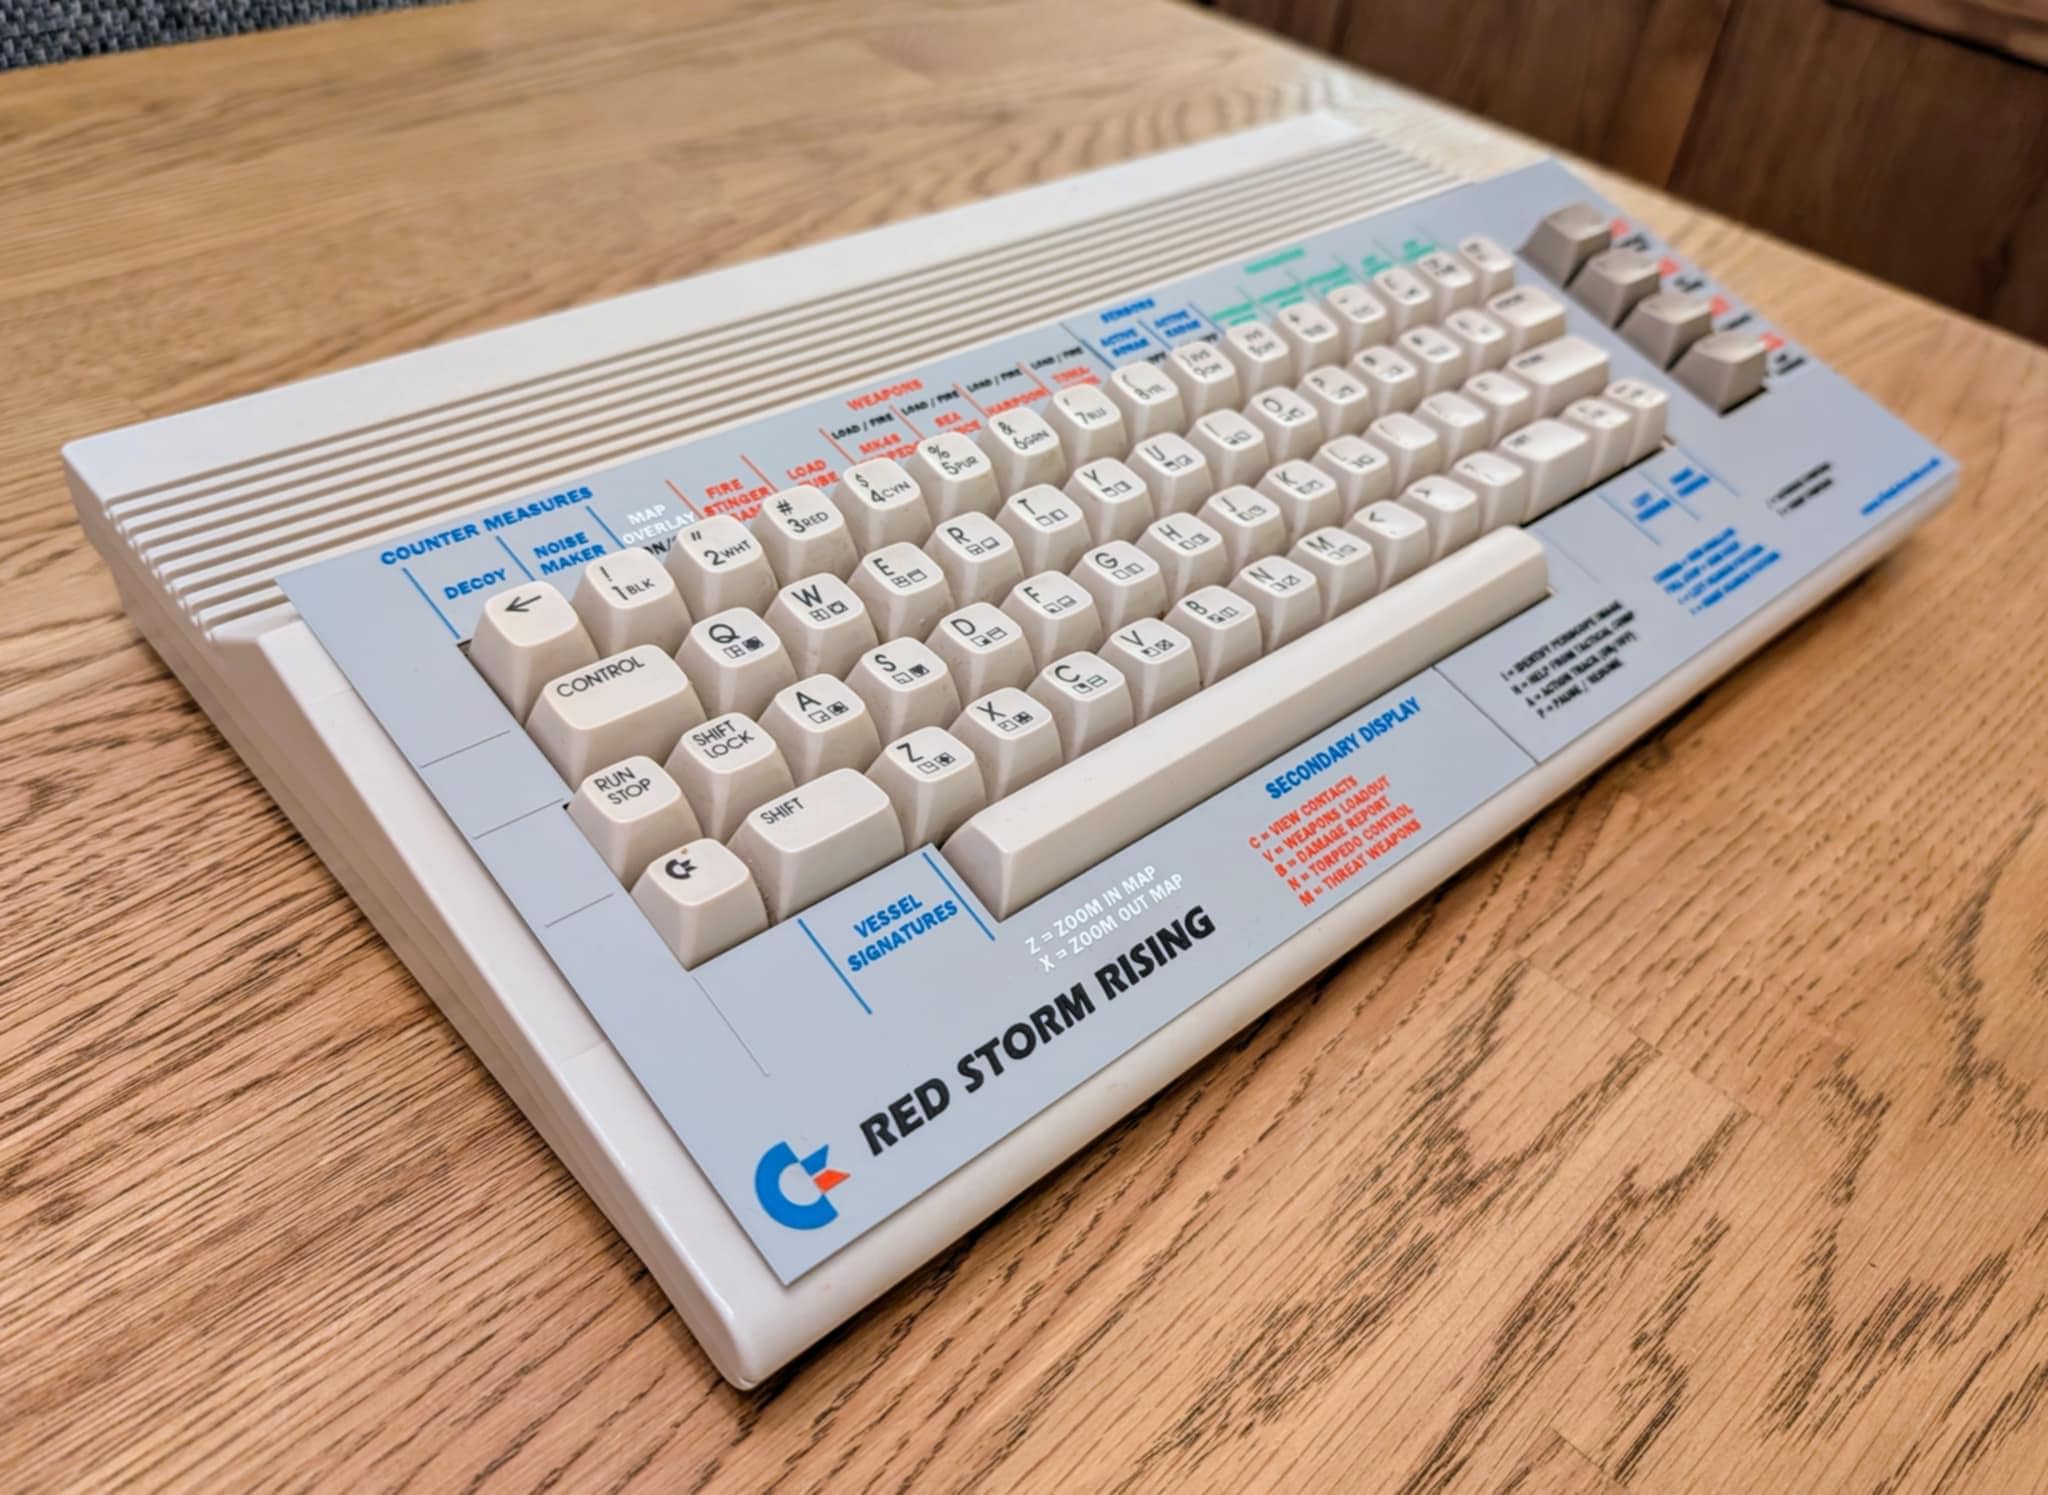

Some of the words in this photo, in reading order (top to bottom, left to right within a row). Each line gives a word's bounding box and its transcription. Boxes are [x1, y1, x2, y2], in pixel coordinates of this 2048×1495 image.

[847, 378, 923, 411] WEAPONS
[901, 399, 928, 416] LOAD
[937, 390, 960, 405] FIRE
[1262, 398, 1283, 414] O
[832, 423, 860, 440] LOAD
[869, 413, 894, 428] FIRE
[1145, 446, 1165, 462] U
[787, 460, 826, 480] LOAD
[1084, 470, 1103, 485] Y
[1276, 471, 1298, 486] K
[705, 479, 743, 498] FIRE
[626, 504, 666, 525] MAP
[703, 487, 771, 517] STINGER
[1018, 498, 1037, 515] T
[380, 523, 480, 566] COUNTER
[483, 486, 593, 532] MEASURES
[623, 511, 695, 544] OVERLAY
[947, 526, 969, 545] R
[1159, 524, 1183, 541] H
[532, 532, 590, 559] NOISE
[1306, 536, 1334, 552] M
[540, 545, 607, 576] MAKER
[873, 558, 895, 576] E
[1095, 552, 1119, 569] G
[444, 568, 507, 600] DECOY
[1248, 568, 1275, 583] N
[791, 584, 823, 608] W
[1024, 586, 1044, 604] F
[1185, 600, 1208, 616] B
[708, 623, 741, 644] Q
[950, 618, 977, 637] D
[1120, 630, 1147, 648] V
[874, 654, 897, 674] S
[1054, 664, 1081, 684] C
[556, 656, 646, 698] CONTROL
[795, 691, 822, 712] A
[977, 701, 1006, 721] X
[692, 720, 739, 748] SHIFT
[704, 731, 756, 760] LOCK
[898, 743, 924, 763] Z
[1265, 733, 1361, 799] SECONDARY
[1358, 696, 1421, 743] DISPLAY
[594, 767, 637, 792] RUN
[608, 778, 652, 806] STOP
[760, 798, 806, 825] SHIFT
[1248, 836, 1261, 849] C
[1269, 811, 1300, 837] VIEW
[1301, 775, 1358, 816] CONTACTS
[1263, 851, 1275, 863] V
[1283, 809, 1341, 850] WEAPONS
[1340, 775, 1390, 814] LOADOUT
[1274, 864, 1288, 877] B
[1297, 824, 1346, 864] DAMAGE
[1346, 797, 1391, 831] REPORT
[1288, 877, 1301, 891] N
[1309, 837, 1363, 876] TORPEDO
[1363, 804, 1414, 840] CONTROL
[1299, 891, 1315, 907] M
[1323, 858, 1368, 891] THREAT
[1366, 819, 1422, 861] WEAPONS
[854, 894, 923, 938] VESSEL
[1024, 936, 1039, 955] Z
[1053, 902, 1104, 938] ZOOM
[1104, 889, 1121, 909] IN
[1119, 865, 1157, 897] MAP
[848, 900, 959, 971] SIGNATURES
[1039, 955, 1055, 973] X
[1068, 916, 1119, 956] ZOOM
[1118, 895, 1152, 921] OUT
[1149, 873, 1185, 906] MAP
[859, 1077, 951, 1157] RED
[956, 982, 1096, 1093] STORM
[1093, 905, 1216, 1000] RISING
